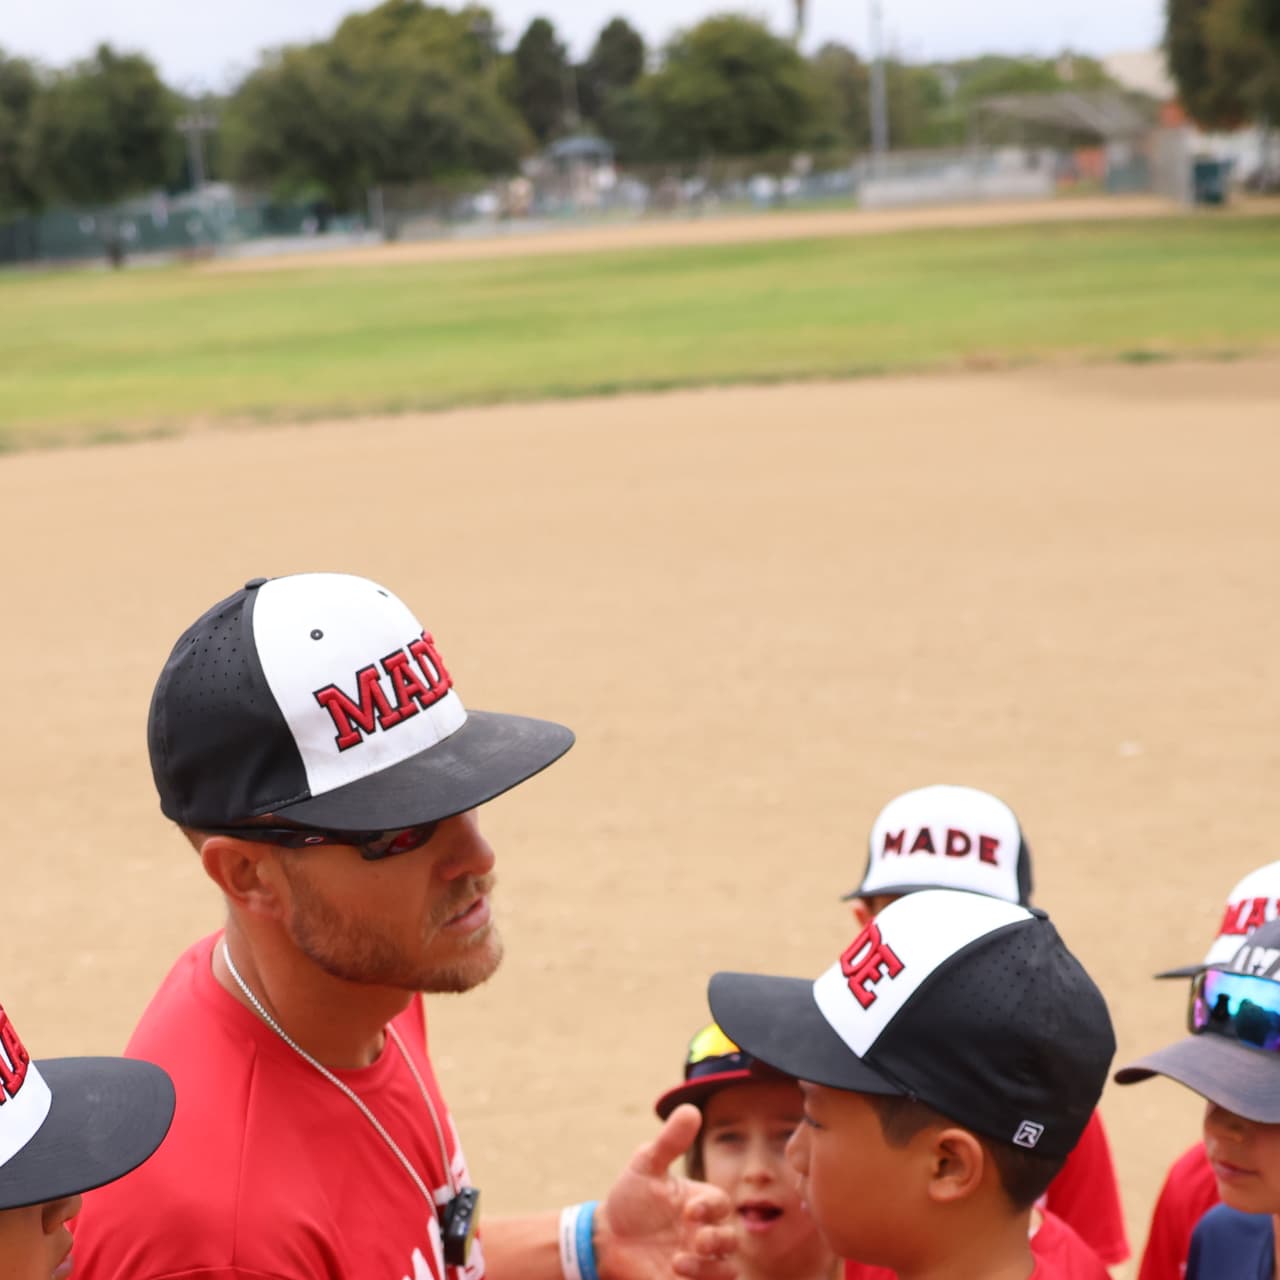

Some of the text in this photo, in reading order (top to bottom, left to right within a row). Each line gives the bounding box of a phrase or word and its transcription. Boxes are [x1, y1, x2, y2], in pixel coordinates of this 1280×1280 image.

[313, 629, 453, 752] MAD
[881, 826, 1000, 867] MADE
[840, 914, 906, 1009] DE
